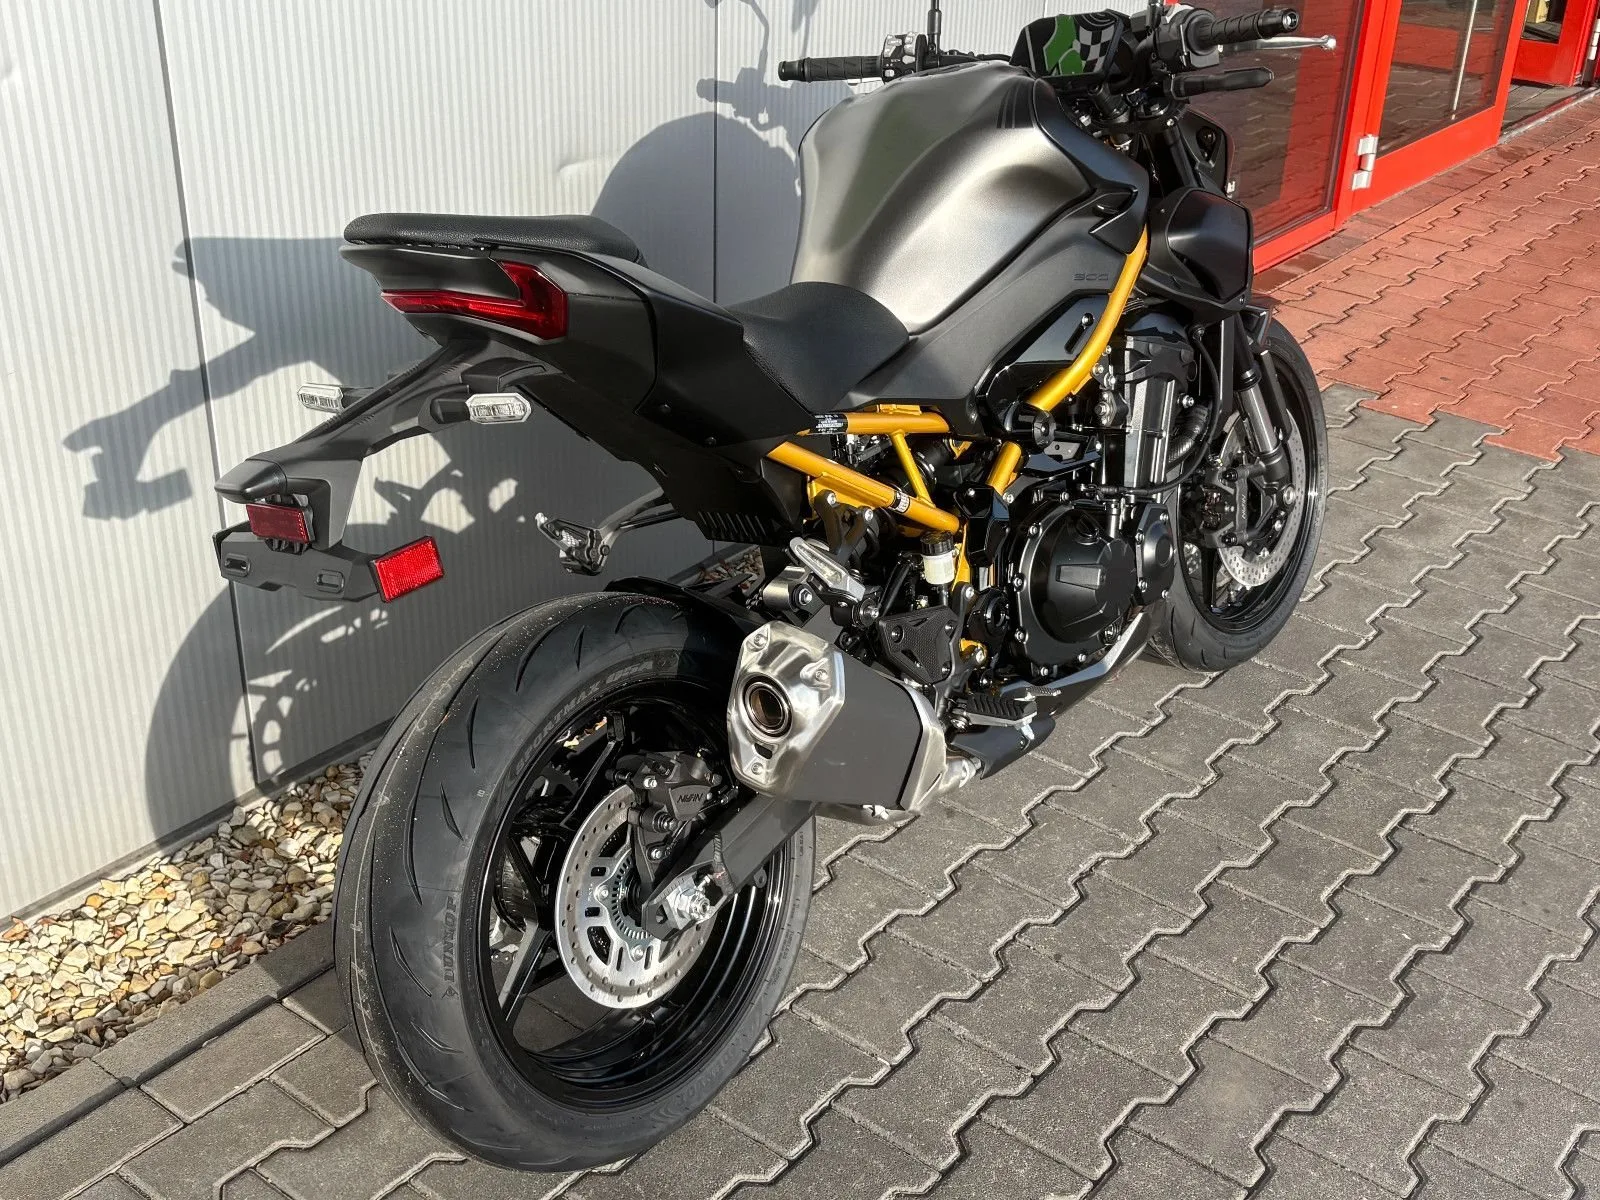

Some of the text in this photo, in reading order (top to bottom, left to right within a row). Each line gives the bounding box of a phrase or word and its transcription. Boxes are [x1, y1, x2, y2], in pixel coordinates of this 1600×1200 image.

[515, 680, 602, 776] SPORTMAX
[676, 792, 704, 804] NISSIN
[441, 896, 457, 983] DUNLOP
